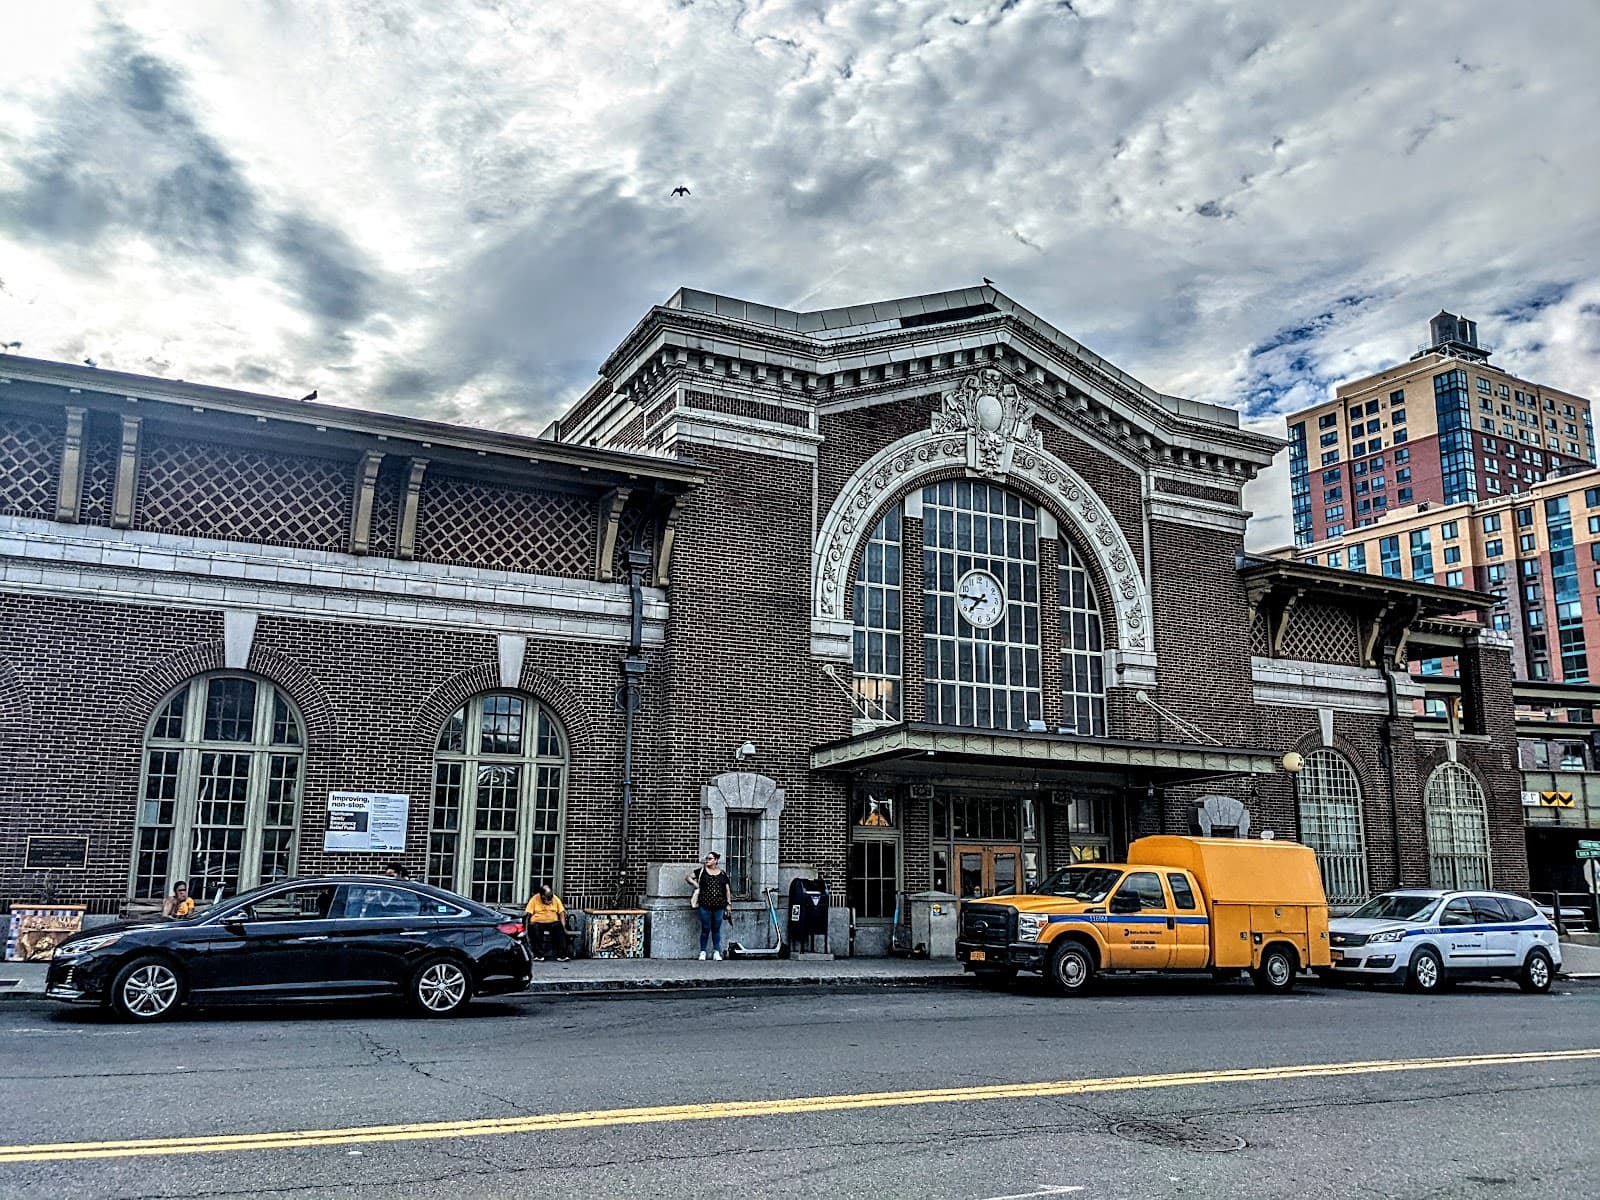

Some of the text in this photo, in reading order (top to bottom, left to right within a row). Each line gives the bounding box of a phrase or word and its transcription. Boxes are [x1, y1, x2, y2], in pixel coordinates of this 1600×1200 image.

[969, 578, 974, 587] 11
[976, 576, 982, 584] 12
[962, 585, 969, 593] 10
[990, 588, 996, 596] 2
[994, 598, 998, 606] 3
[332, 794, 370, 803] Improving,
